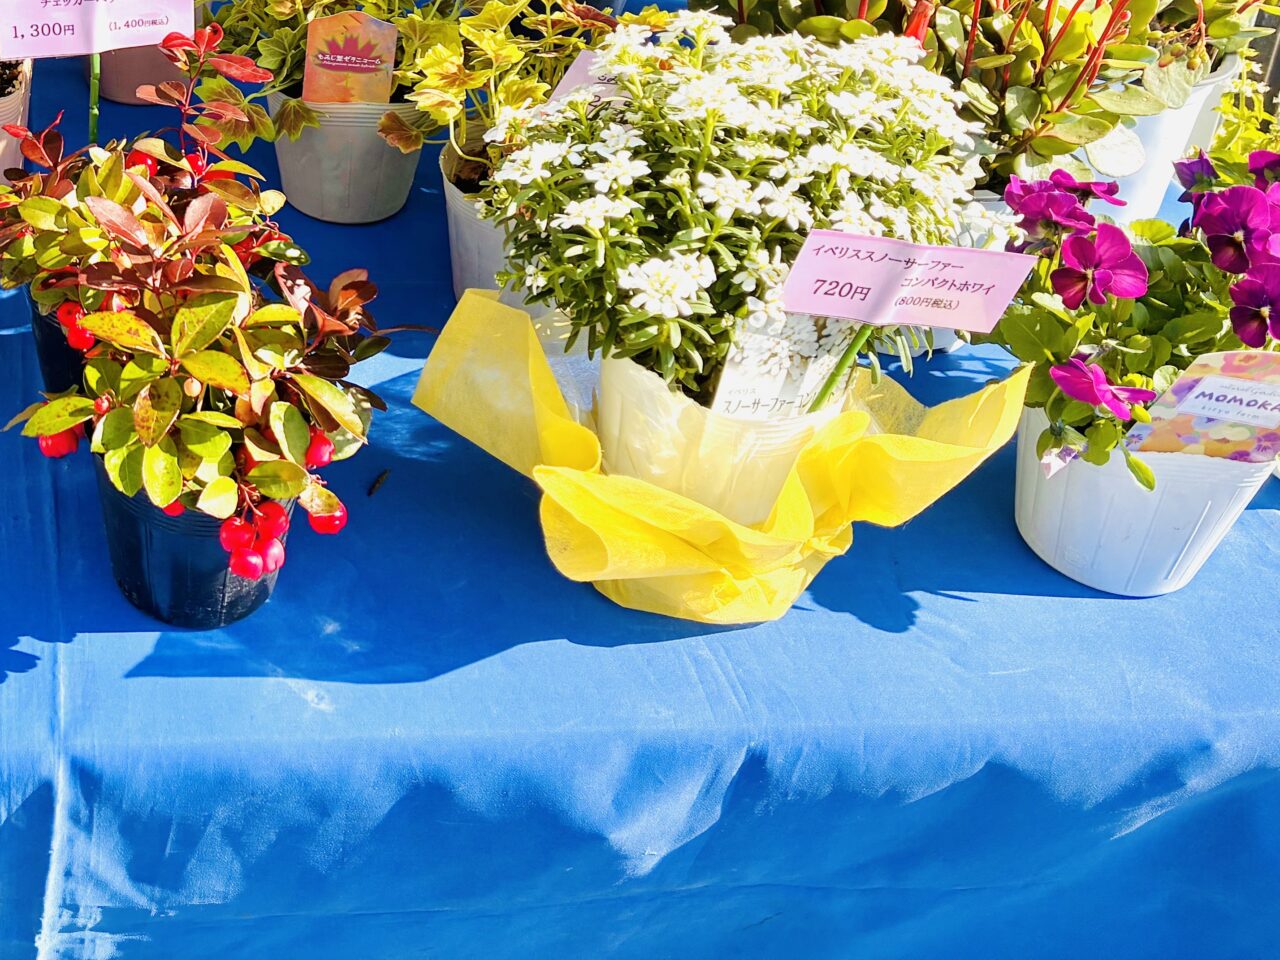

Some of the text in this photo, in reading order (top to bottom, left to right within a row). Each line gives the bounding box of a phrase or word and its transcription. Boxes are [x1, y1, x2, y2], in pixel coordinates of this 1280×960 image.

[12, 15, 170, 39] 1,300円 (1,400円税込)
[812, 244, 964, 272] イベリススノーサーファー
[812, 279, 961, 311] 720円 (800円税込)
[901, 277, 996, 296] コンパクトホワイ
